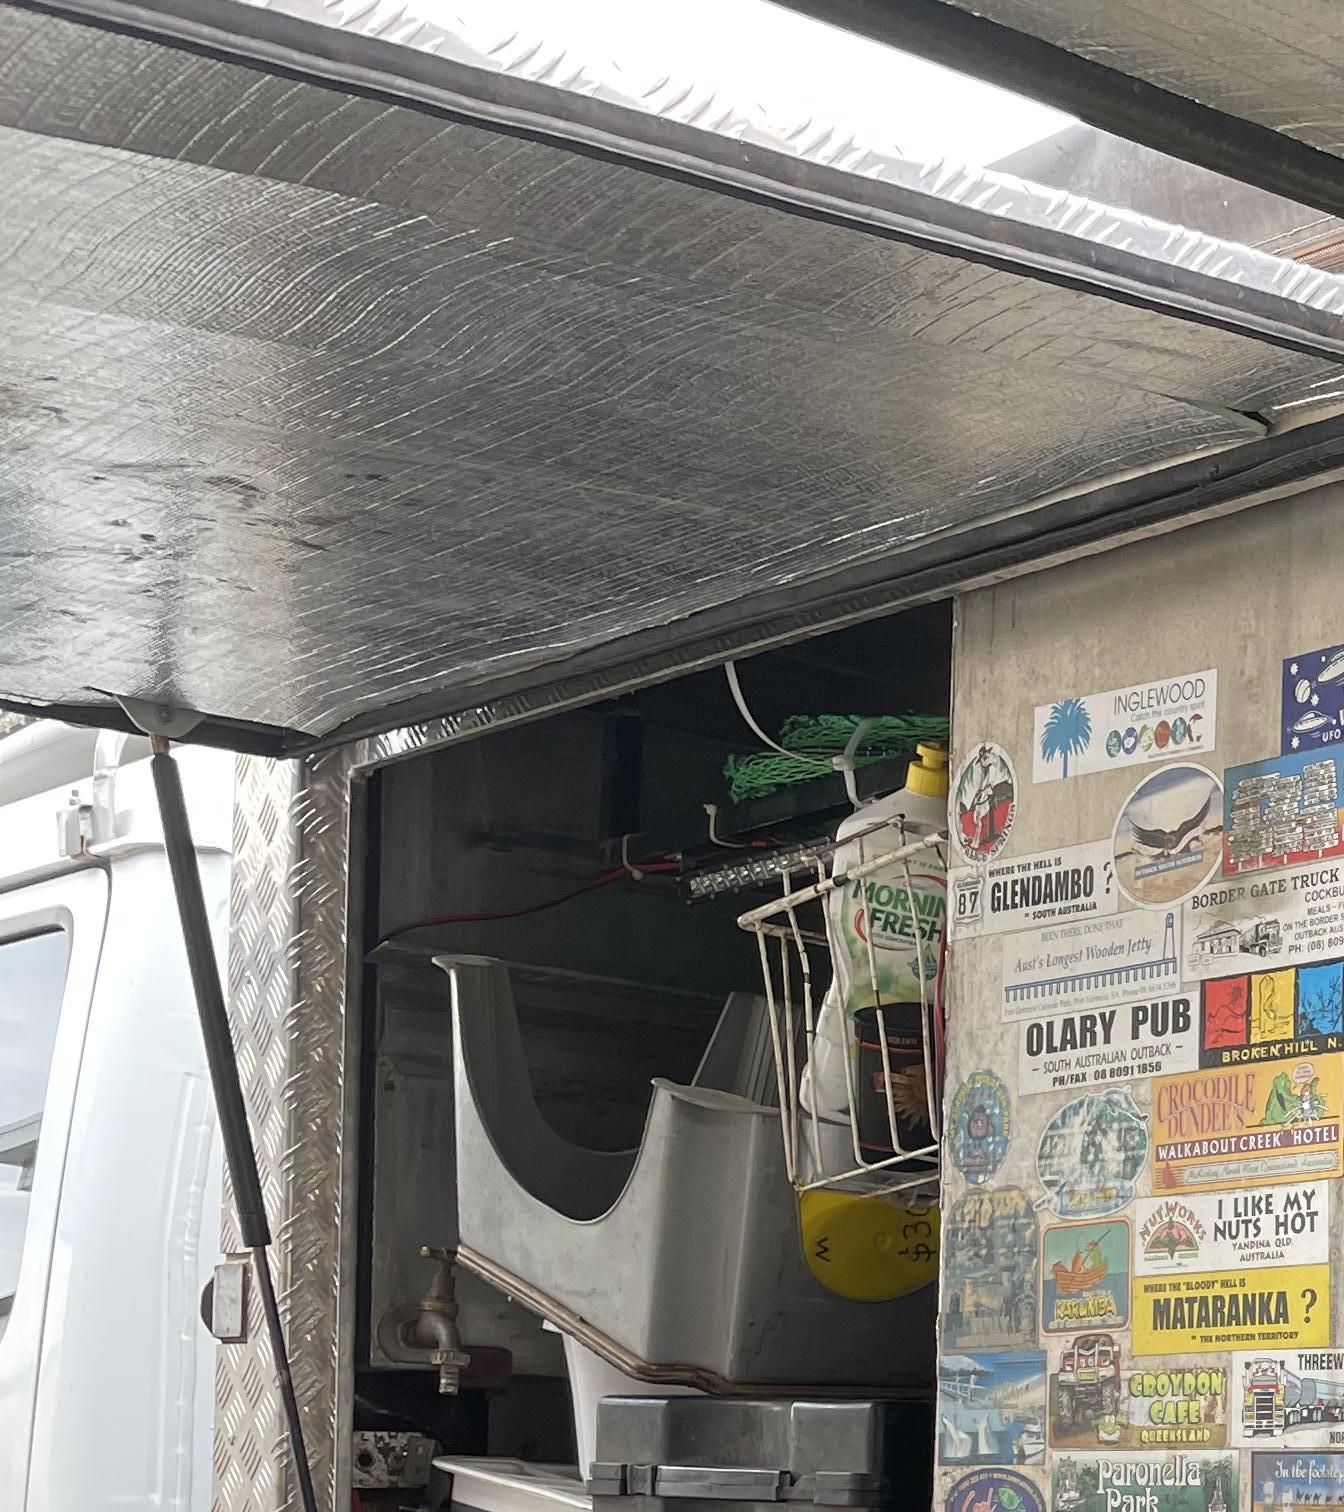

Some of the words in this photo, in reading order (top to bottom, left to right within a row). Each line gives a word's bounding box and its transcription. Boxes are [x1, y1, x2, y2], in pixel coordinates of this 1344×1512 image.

[1113, 678, 1206, 715] INGLEWOOD
[1321, 730, 1341, 742] UFO
[988, 866, 1015, 878] WHERE
[1017, 862, 1032, 873] THE
[1034, 859, 1052, 870] HELL
[1054, 856, 1062, 866] IS
[852, 879, 946, 918] MORNIN
[990, 865, 1094, 913] GLENDAMBO
[1103, 861, 1113, 894] ?
[1191, 886, 1245, 910] BORDER
[1250, 879, 1287, 898] GATE
[1291, 868, 1339, 891] TRUCK
[958, 890, 979, 916] 87
[1032, 907, 1057, 920] SOUTH
[1057, 902, 1097, 916] AUSTRALIA
[1308, 903, 1331, 916] MEALS
[1282, 922, 1293, 931] ON
[1295, 919, 1308, 929] THE
[1309, 913, 1339, 927] BORDER
[1294, 928, 1328, 941] OUTBACK
[1041, 931, 1059, 942] BEEN
[1307, 939, 1325, 952] (08)
[1015, 956, 1044, 973] Aust's
[1046, 951, 1083, 969] Longest
[1085, 942, 1125, 960] Wooden
[1125, 937, 1152, 957] Jetty
[1026, 1010, 1117, 1057] OLARY
[1131, 998, 1191, 1041] PUB
[1043, 1057, 1071, 1074] SOUTH
[1074, 1050, 1127, 1069] AUSTRALIAN
[1130, 1043, 1172, 1060] OUTBACK
[1221, 1043, 1281, 1064] BROKEN
[1284, 1038, 1318, 1056] HILL
[1052, 1071, 1087, 1087] PH/FAX
[1093, 1068, 1107, 1081] 08
[1109, 1064, 1135, 1079] 8091
[1157, 1072, 1256, 1124] CROCODILE
[1168, 1101, 1245, 1138] DUNDEE'S
[1158, 1137, 1237, 1160] WALKABOUT
[1239, 1132, 1281, 1151] CREEK
[1292, 1126, 1337, 1144] HOTEL
[1217, 1199, 1223, 1219] I
[1233, 1193, 1274, 1218] LIKE
[1283, 1189, 1316, 1213] MY
[1213, 1217, 1262, 1242] NUTS
[1275, 1211, 1319, 1236] HOT
[1232, 1240, 1271, 1251] YANDINA
[1239, 1250, 1285, 1262] AUSTRALIA
[1143, 1283, 1167, 1293] WHERE
[1169, 1282, 1181, 1292] THE
[1220, 1278, 1237, 1288] HELL
[1238, 1277, 1246, 1287] IS
[1056, 1295, 1117, 1320] KARUMBA
[1152, 1290, 1289, 1331] MATARANKA
[1300, 1288, 1318, 1324] ?
[1200, 1335, 1214, 1343] THE
[1215, 1332, 1256, 1343] NORTHERN
[1257, 1330, 1299, 1342] TERRITORY
[1129, 1371, 1223, 1398] CROYDON
[1149, 1400, 1201, 1425] CAFE
[1140, 1429, 1211, 1443] QUEENSLAND
[1096, 1454, 1201, 1494] Paronella
[1275, 1460, 1289, 1478] In
[1291, 1459, 1306, 1478] the
